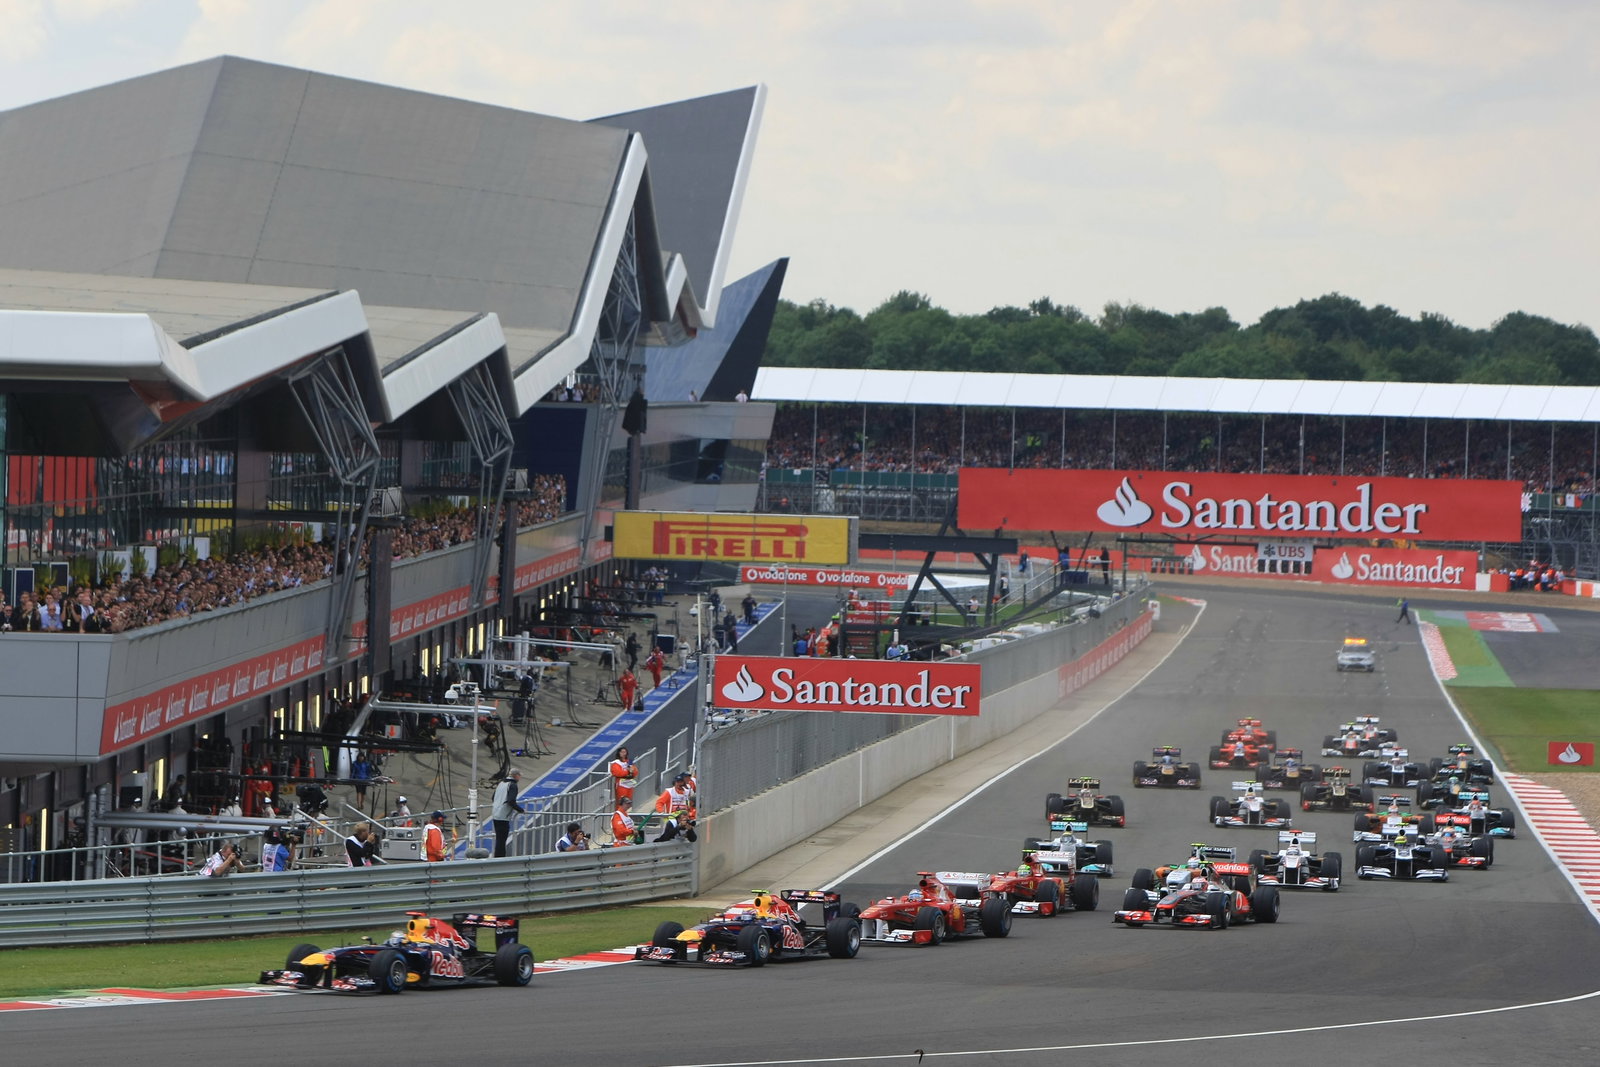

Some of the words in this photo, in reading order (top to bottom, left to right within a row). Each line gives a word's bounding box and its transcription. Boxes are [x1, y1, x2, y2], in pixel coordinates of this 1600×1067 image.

[1161, 481, 1427, 536] Santander
[653, 520, 809, 559] PIRELLI
[1277, 545, 1306, 560] UBS
[826, 571, 871, 585] vodafone
[1356, 554, 1465, 585] Santander
[770, 667, 972, 710] Santander
